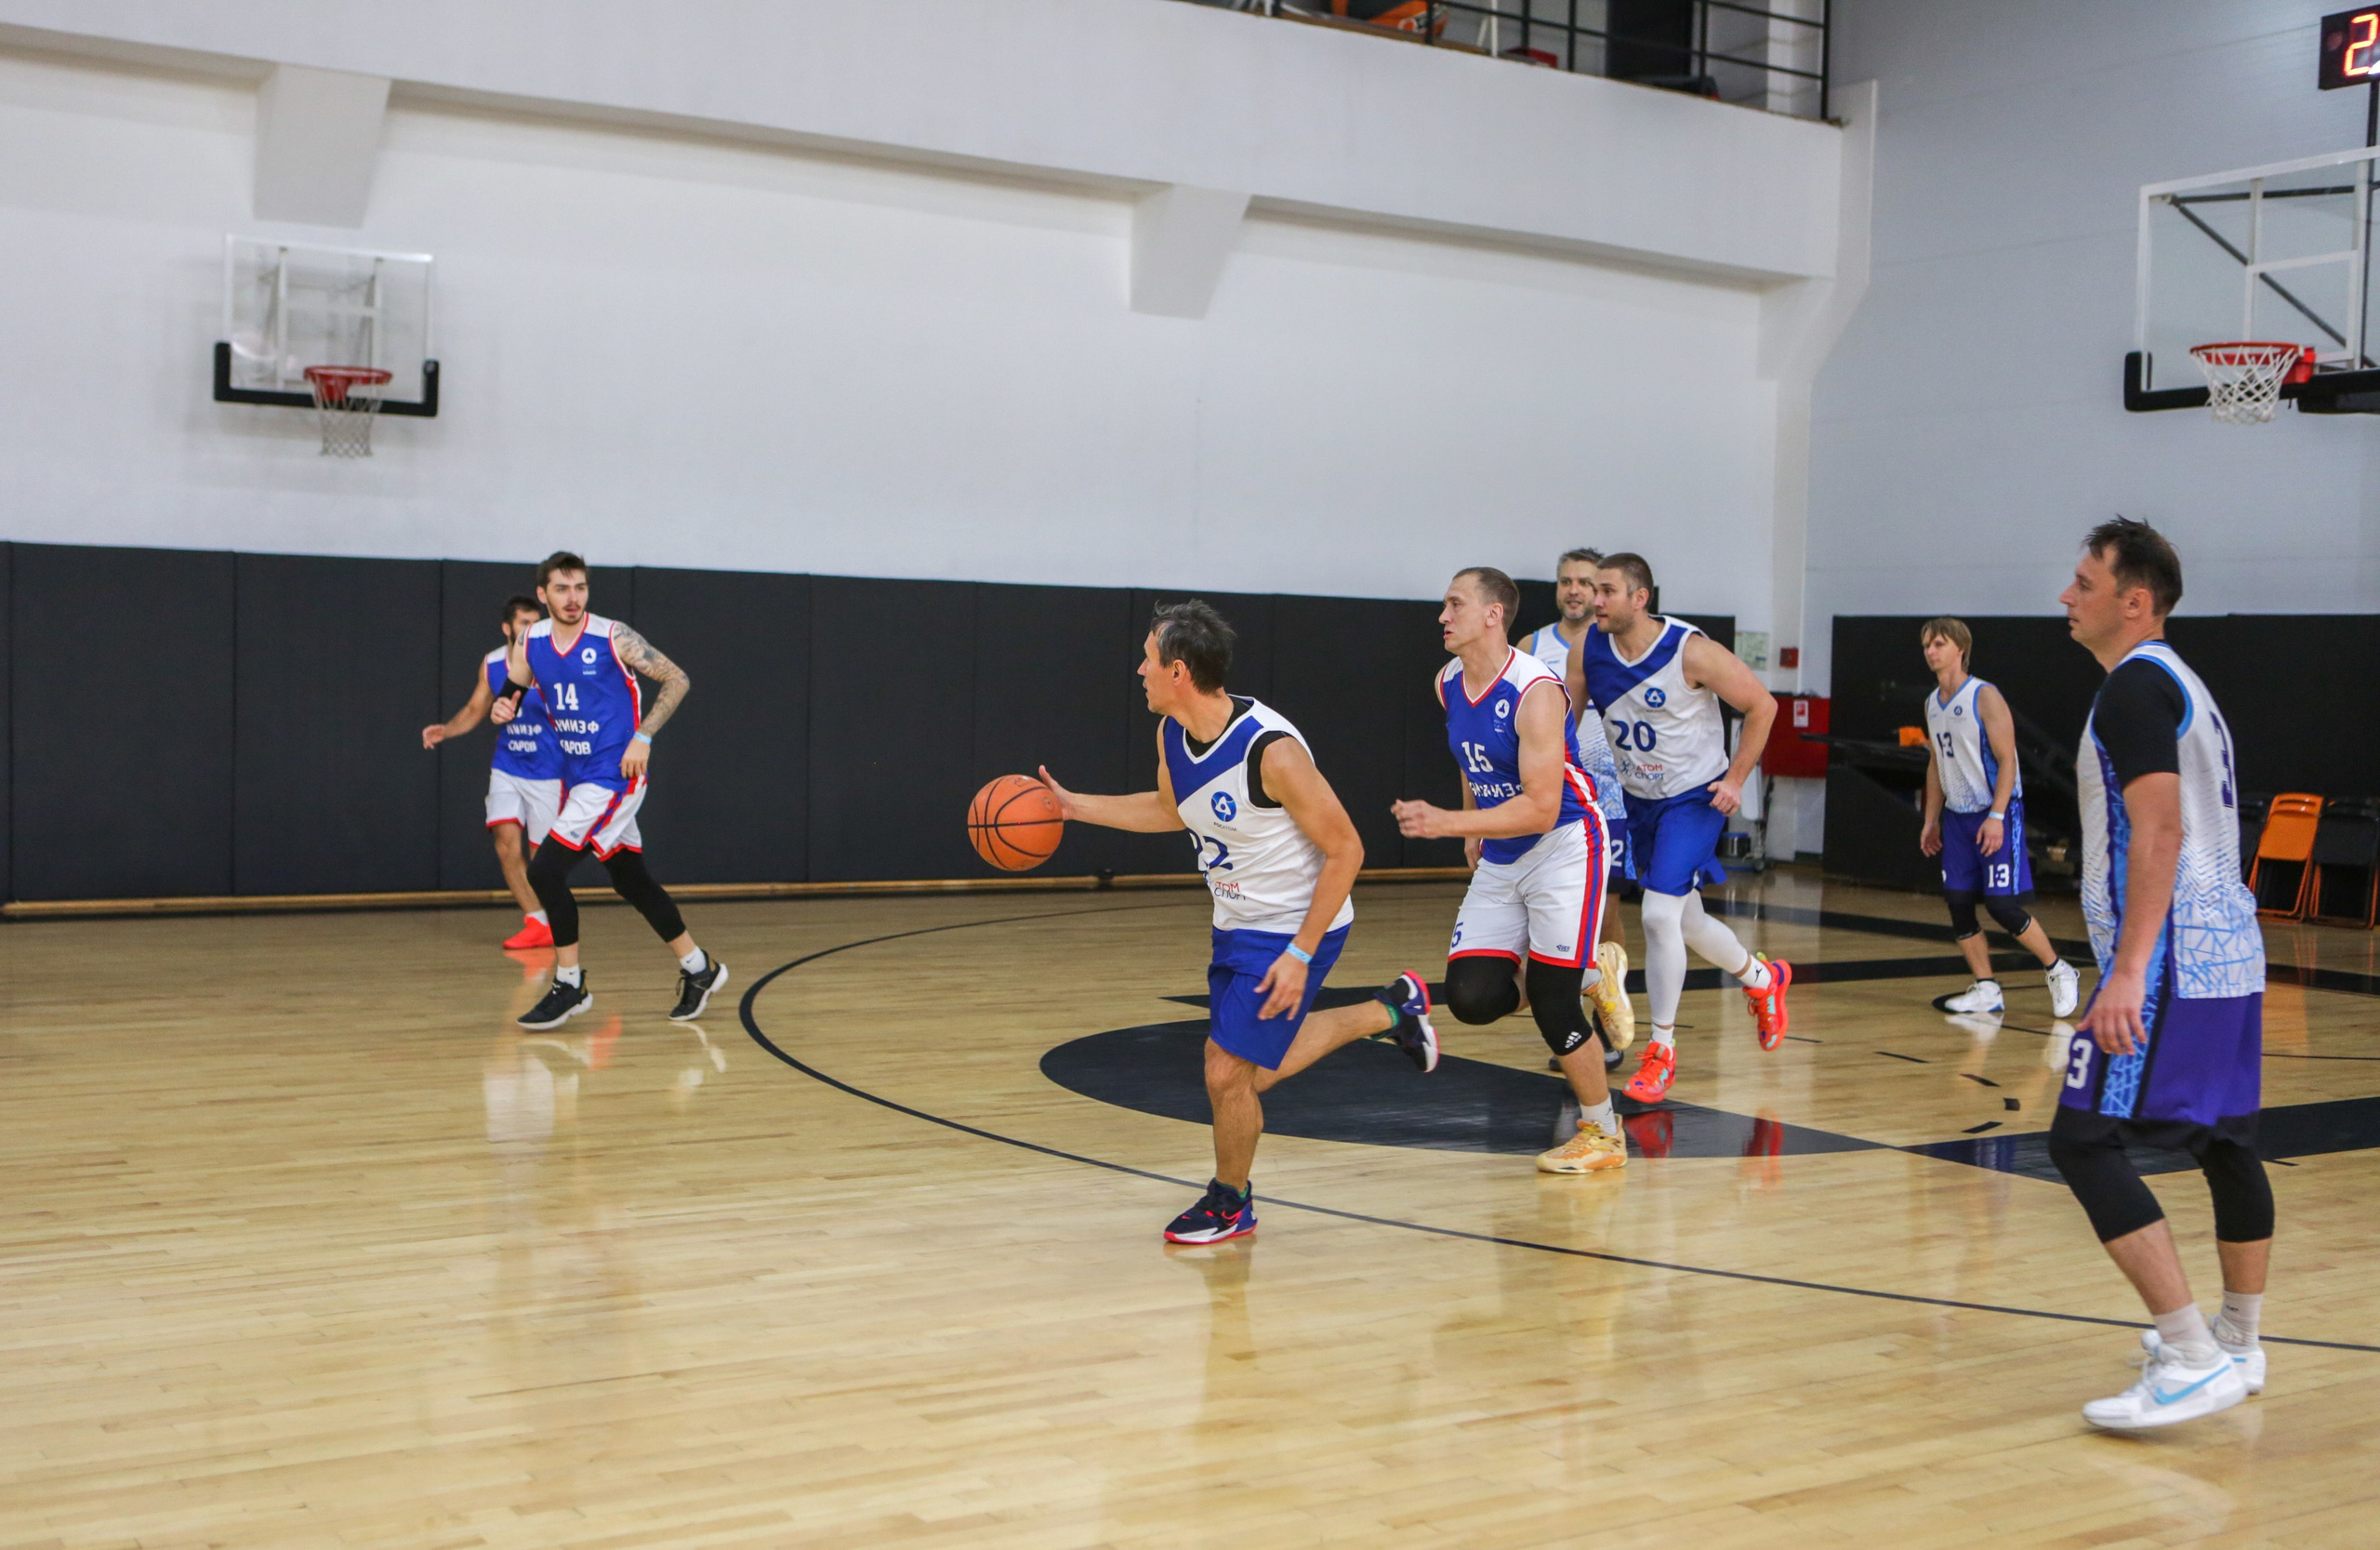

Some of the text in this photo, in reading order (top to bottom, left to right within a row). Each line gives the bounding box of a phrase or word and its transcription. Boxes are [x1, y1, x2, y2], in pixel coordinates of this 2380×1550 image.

[2344, 13, 2379, 76] 2
[553, 682, 579, 710] 14
[1610, 720, 1657, 752] 20
[1936, 732, 1954, 759] 13
[1461, 741, 1493, 773] 15
[1611, 839, 1624, 868] 2
[1988, 864, 2010, 888] 13
[2066, 1038, 2094, 1090] 3
